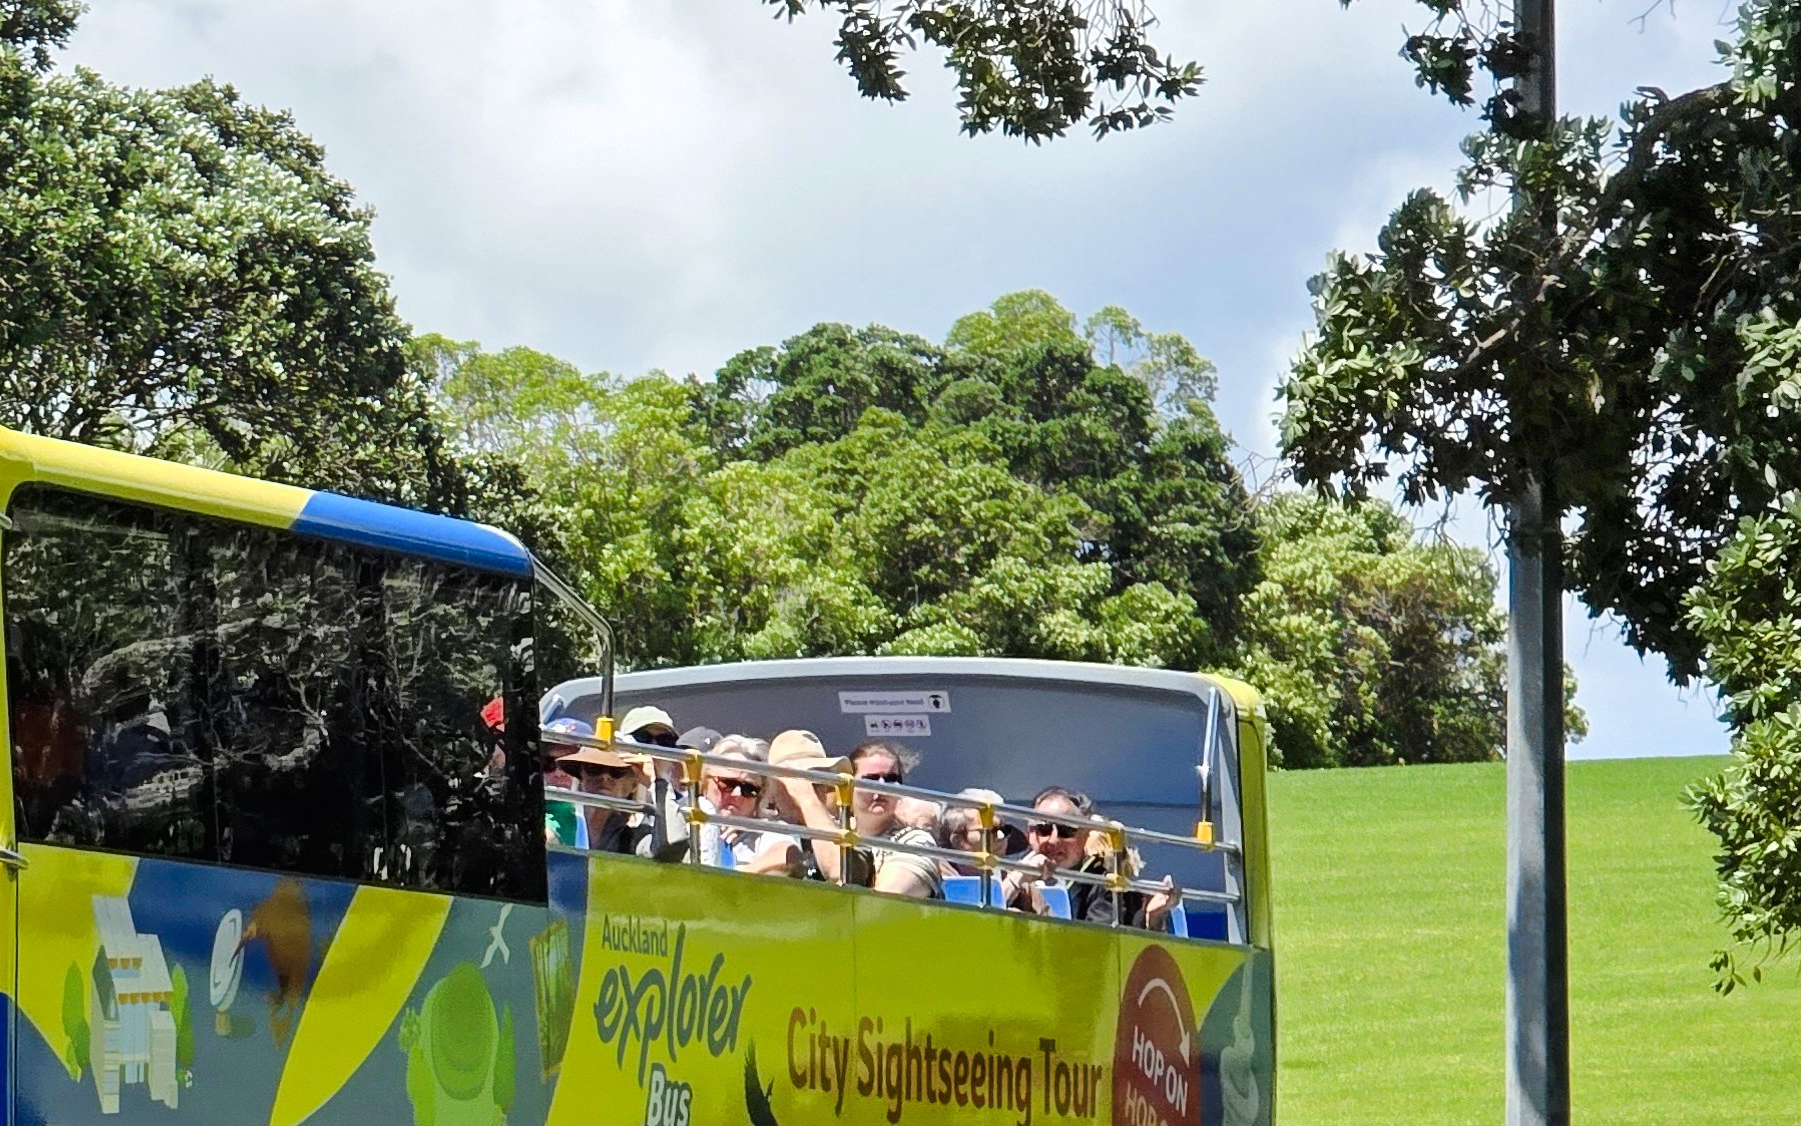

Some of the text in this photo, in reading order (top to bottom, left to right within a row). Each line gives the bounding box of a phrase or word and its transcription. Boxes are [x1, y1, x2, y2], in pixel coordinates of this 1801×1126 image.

[601, 913, 669, 958] Auckland
[593, 921, 752, 1090] explorer
[787, 1006, 849, 1118] City
[1039, 1036, 1102, 1119] Tour
[1132, 1024, 1189, 1118] HOP ON
